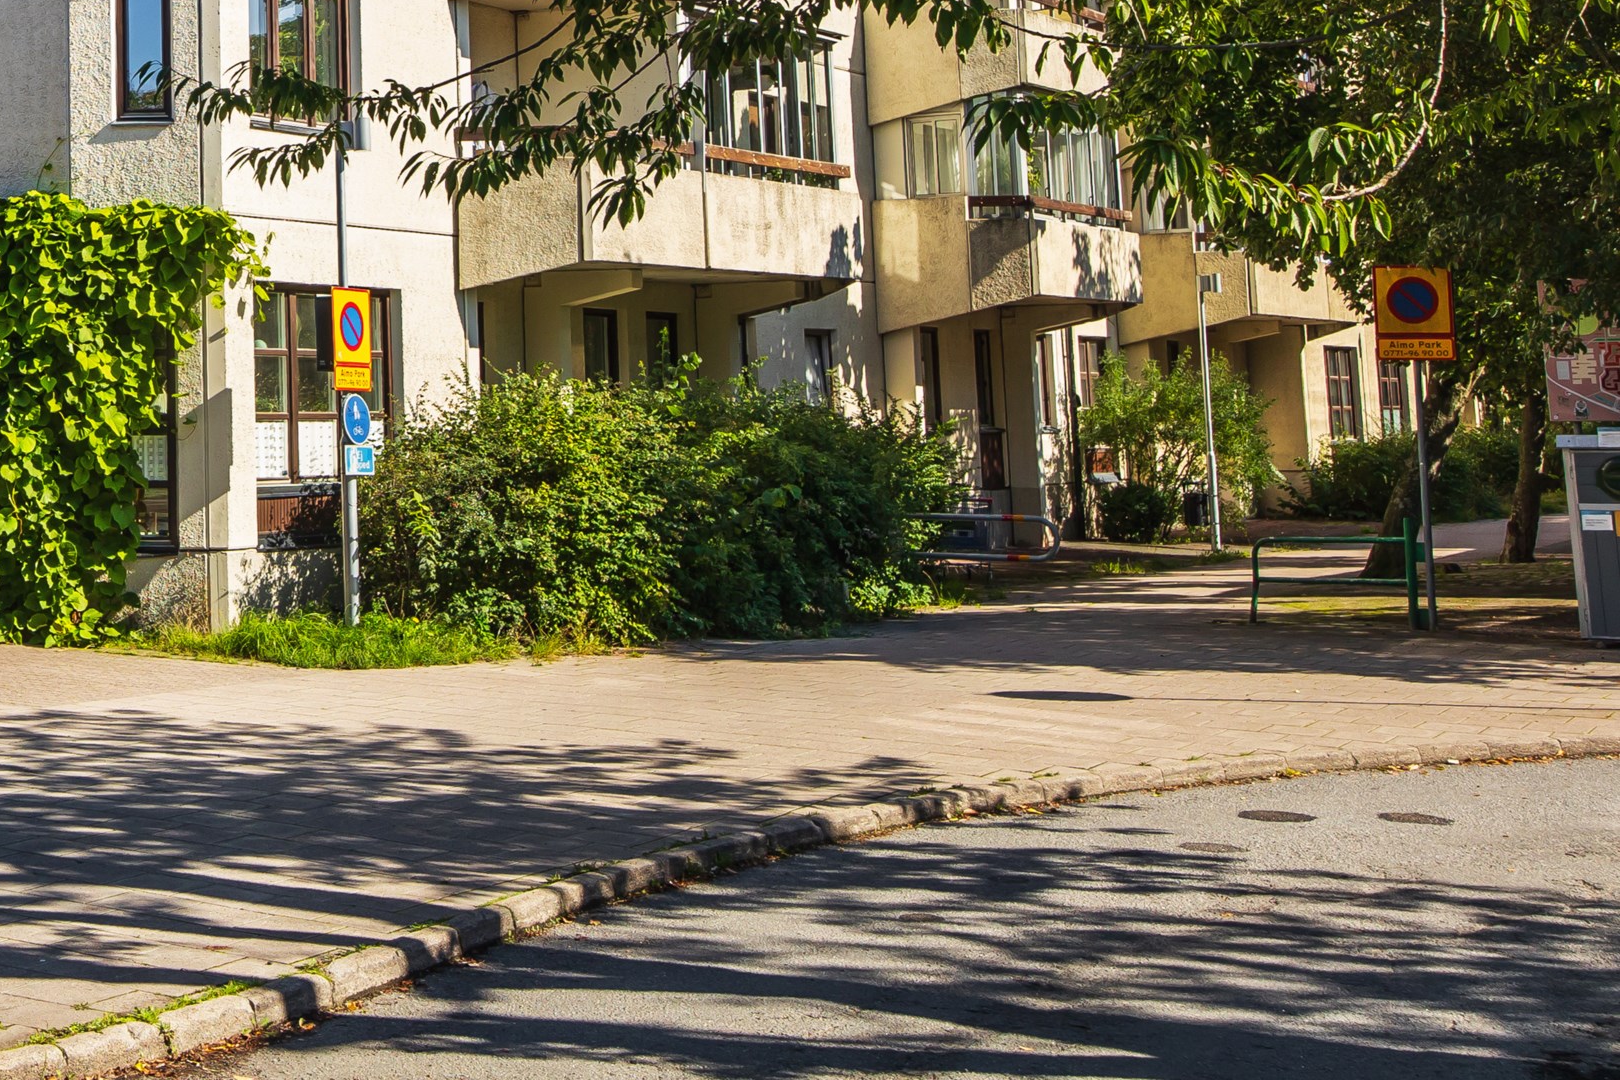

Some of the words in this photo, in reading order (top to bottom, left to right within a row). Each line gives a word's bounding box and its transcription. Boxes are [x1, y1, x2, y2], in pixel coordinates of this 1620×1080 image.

[1389, 341, 1415, 349] Aimo
[1418, 341, 1442, 349] Park
[1383, 349, 1420, 357] 0771-96
[1421, 349, 1434, 357] 90
[1436, 349, 1449, 357] 00
